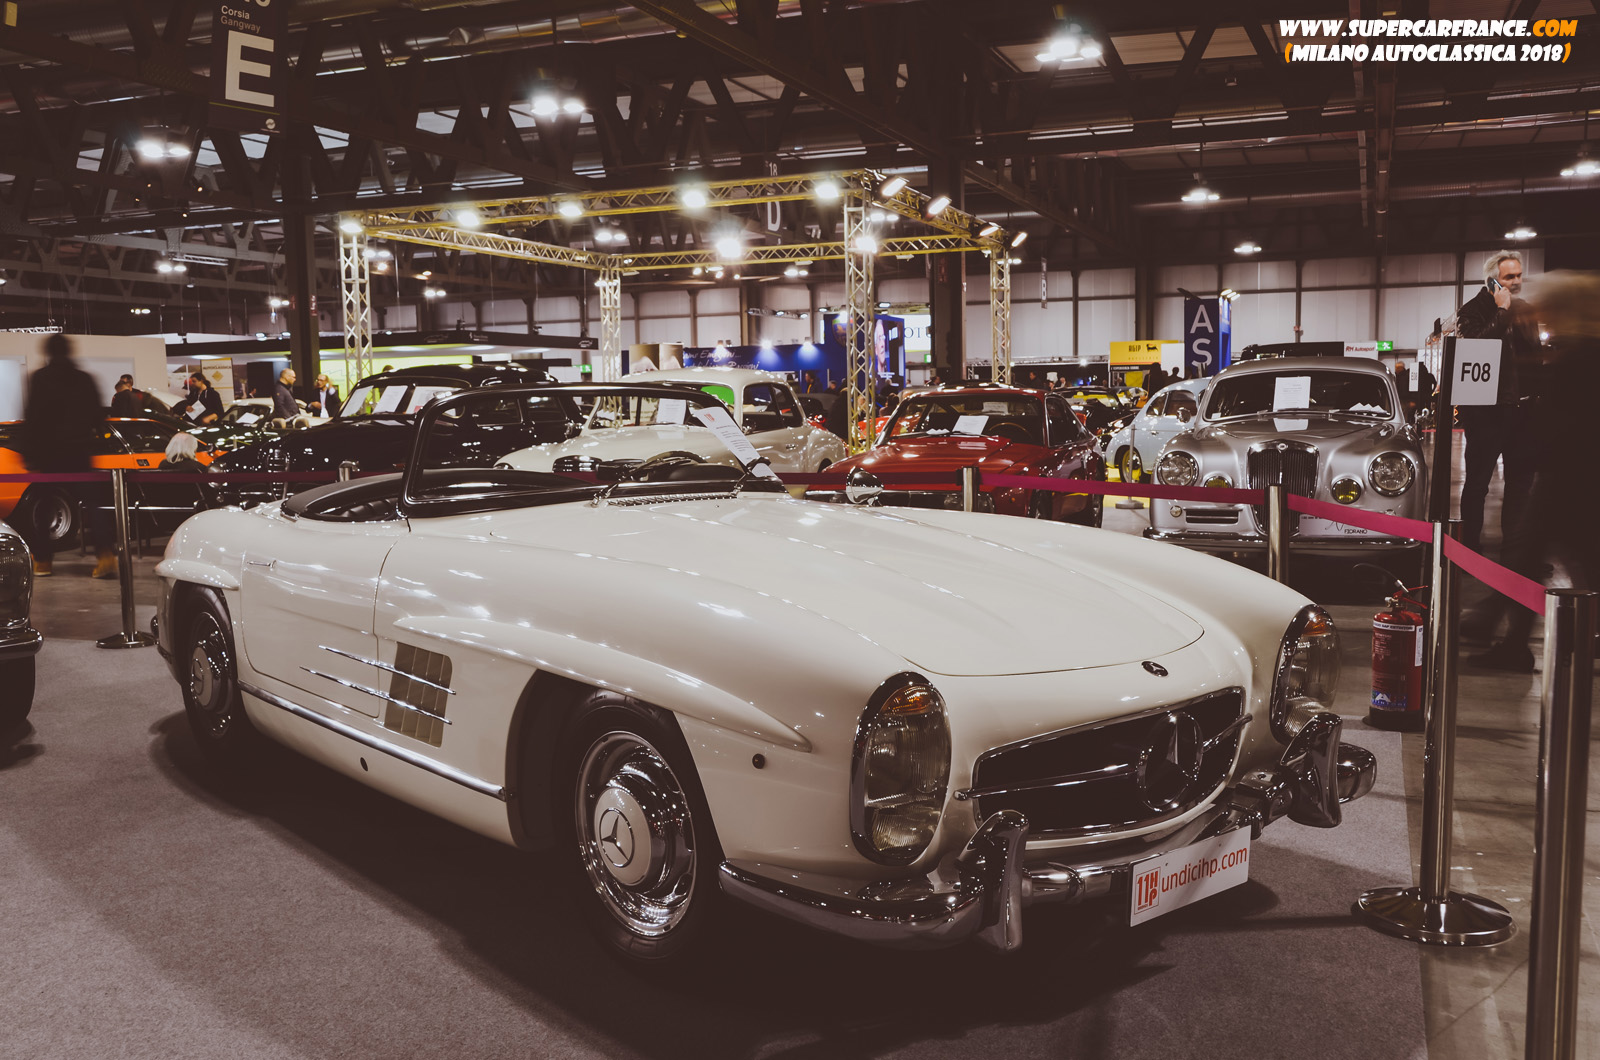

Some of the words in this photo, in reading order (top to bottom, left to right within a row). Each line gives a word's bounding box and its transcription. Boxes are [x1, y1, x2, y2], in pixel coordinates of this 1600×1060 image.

[221, 5, 250, 20] Corsia
[220, 15, 261, 34] Gangway
[225, 30, 275, 108] E
[1460, 362, 1491, 382] F08
[1161, 847, 1248, 893] undicihp.com
